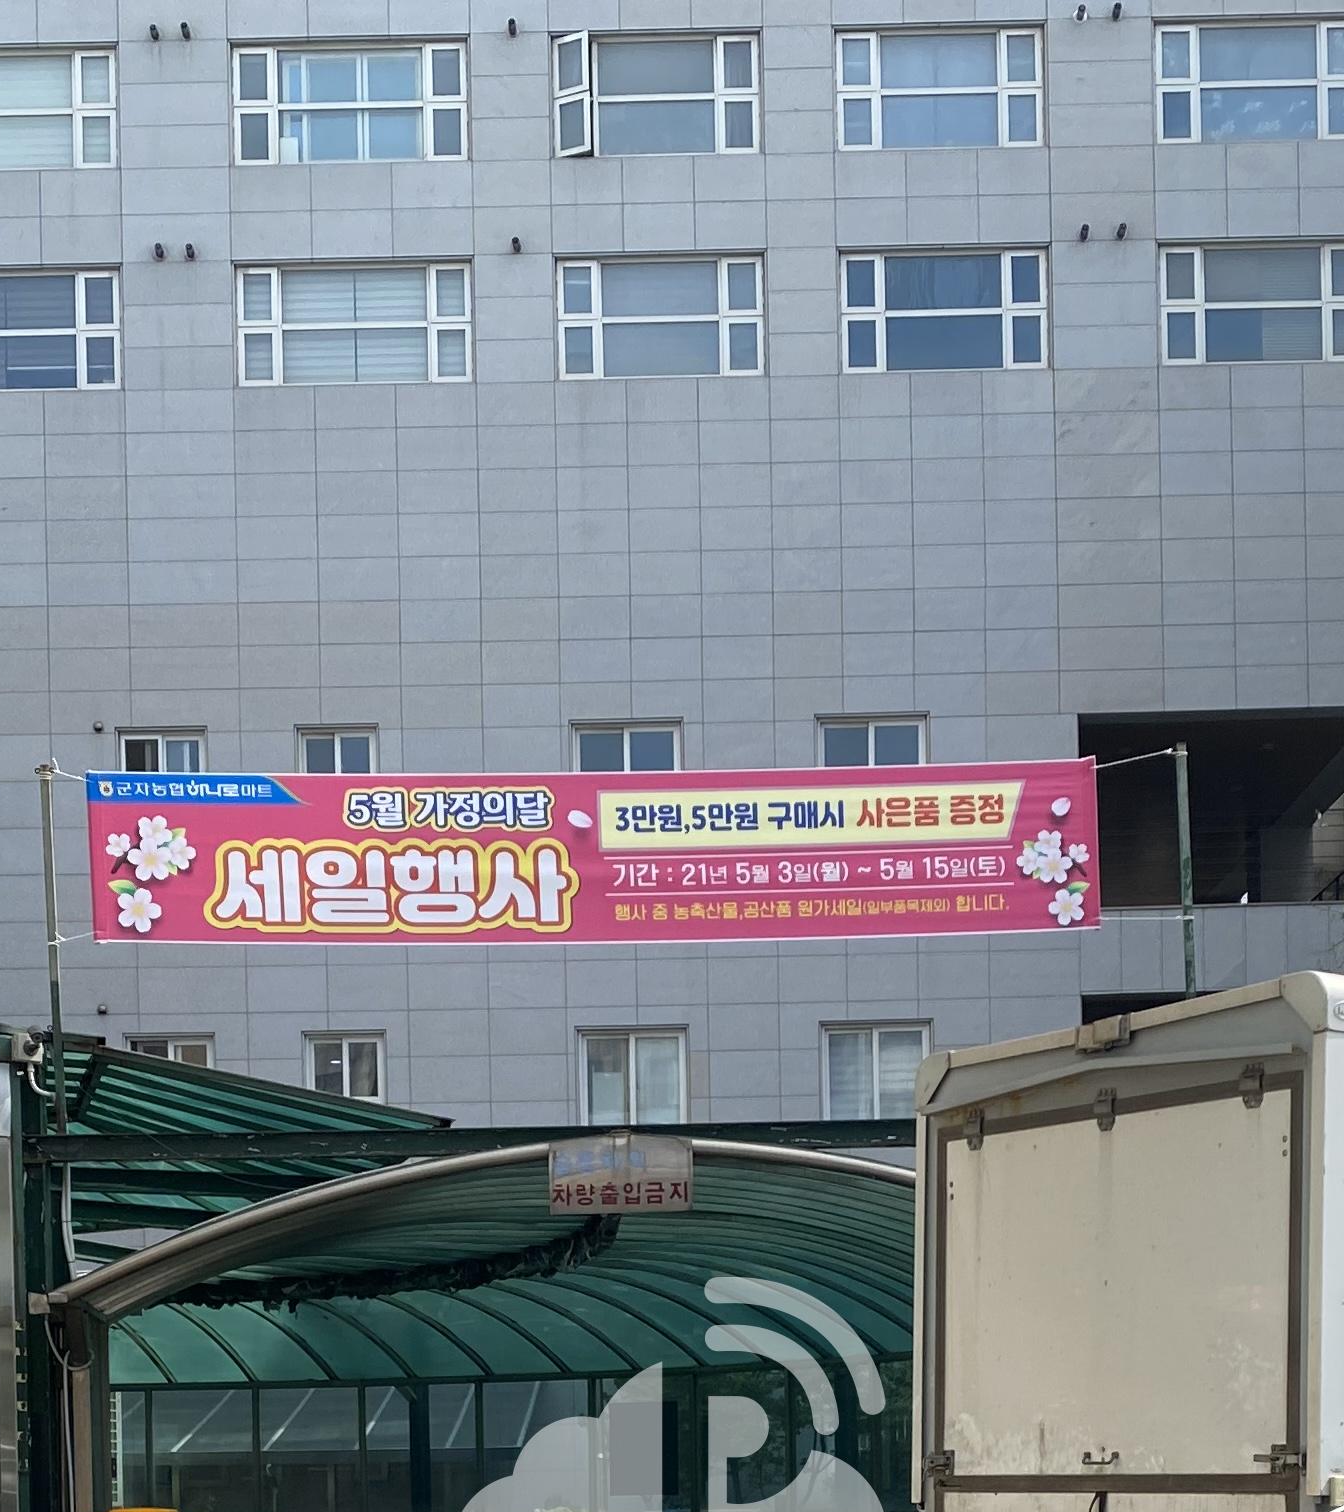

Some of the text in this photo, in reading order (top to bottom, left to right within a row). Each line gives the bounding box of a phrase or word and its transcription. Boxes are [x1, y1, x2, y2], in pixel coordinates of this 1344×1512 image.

[347, 790, 550, 828] 5월 가정의달
[614, 793, 1005, 835] 3만원,5만원 구매시 사은품 증정
[212, 846, 572, 927] 세일행사
[612, 863, 660, 887] 기간
[680, 862, 728, 886] 21년
[735, 861, 770, 884] 5월
[777, 861, 849, 884] 3일(월)
[879, 857, 914, 881] 5월
[922, 856, 1006, 879] 15일(토)
[614, 903, 648, 921] 행사
[652, 903, 669, 920] 중
[955, 893, 1010, 913] 합니다.
